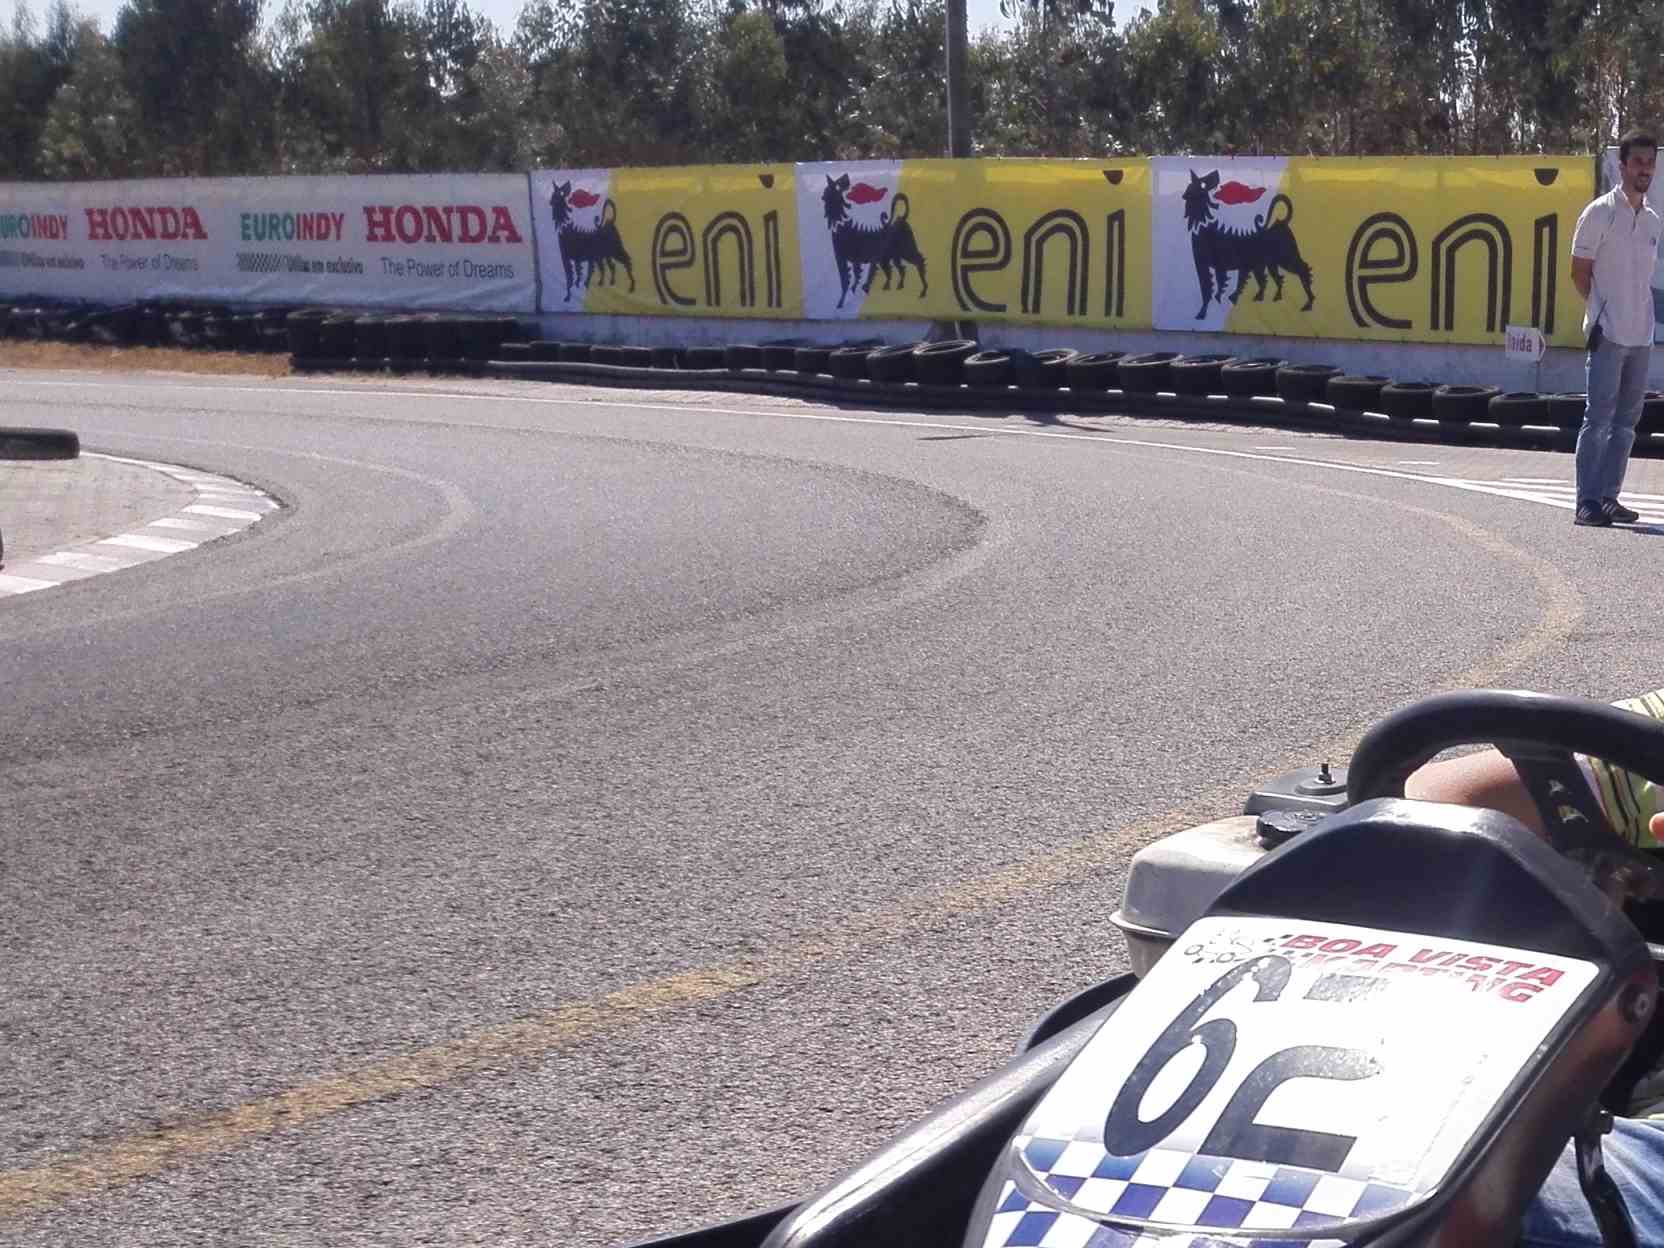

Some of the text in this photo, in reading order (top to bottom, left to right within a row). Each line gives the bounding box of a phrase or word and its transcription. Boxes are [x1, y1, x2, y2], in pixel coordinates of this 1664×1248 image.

[0, 213, 67, 240] UROINDY
[85, 207, 208, 241] HONDA
[362, 205, 522, 243] HONDA
[652, 174, 782, 308] eni
[951, 170, 1124, 313] eni
[380, 256, 513, 279] The Power of Dreams
[1345, 168, 1558, 334] eni
[1281, 933, 1566, 988] BOA VISTA
